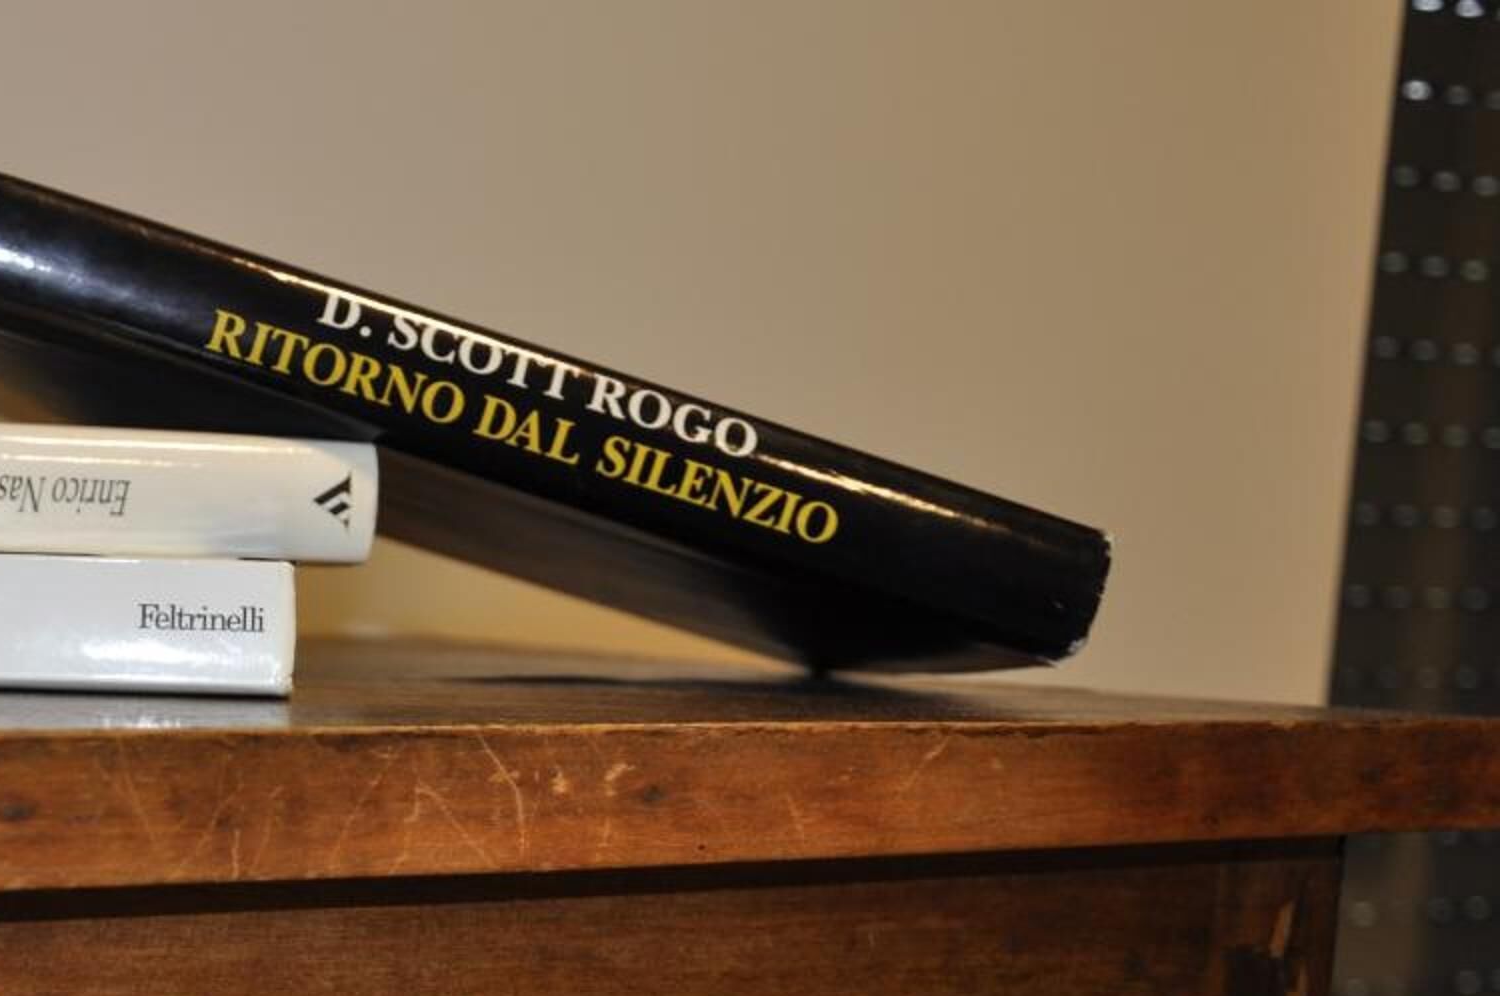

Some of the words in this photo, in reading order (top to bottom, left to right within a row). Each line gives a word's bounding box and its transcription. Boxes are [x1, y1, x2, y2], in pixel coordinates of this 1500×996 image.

[204, 308, 464, 425] RITORNO
[473, 395, 580, 465] DAL
[595, 435, 840, 545] SILENZIO
[317, 290, 372, 338] D.
[386, 309, 583, 400] SCOTT
[586, 370, 758, 459] ROGO
[54, 476, 131, 517] Enrico
[138, 602, 264, 634] Feltrinelli
